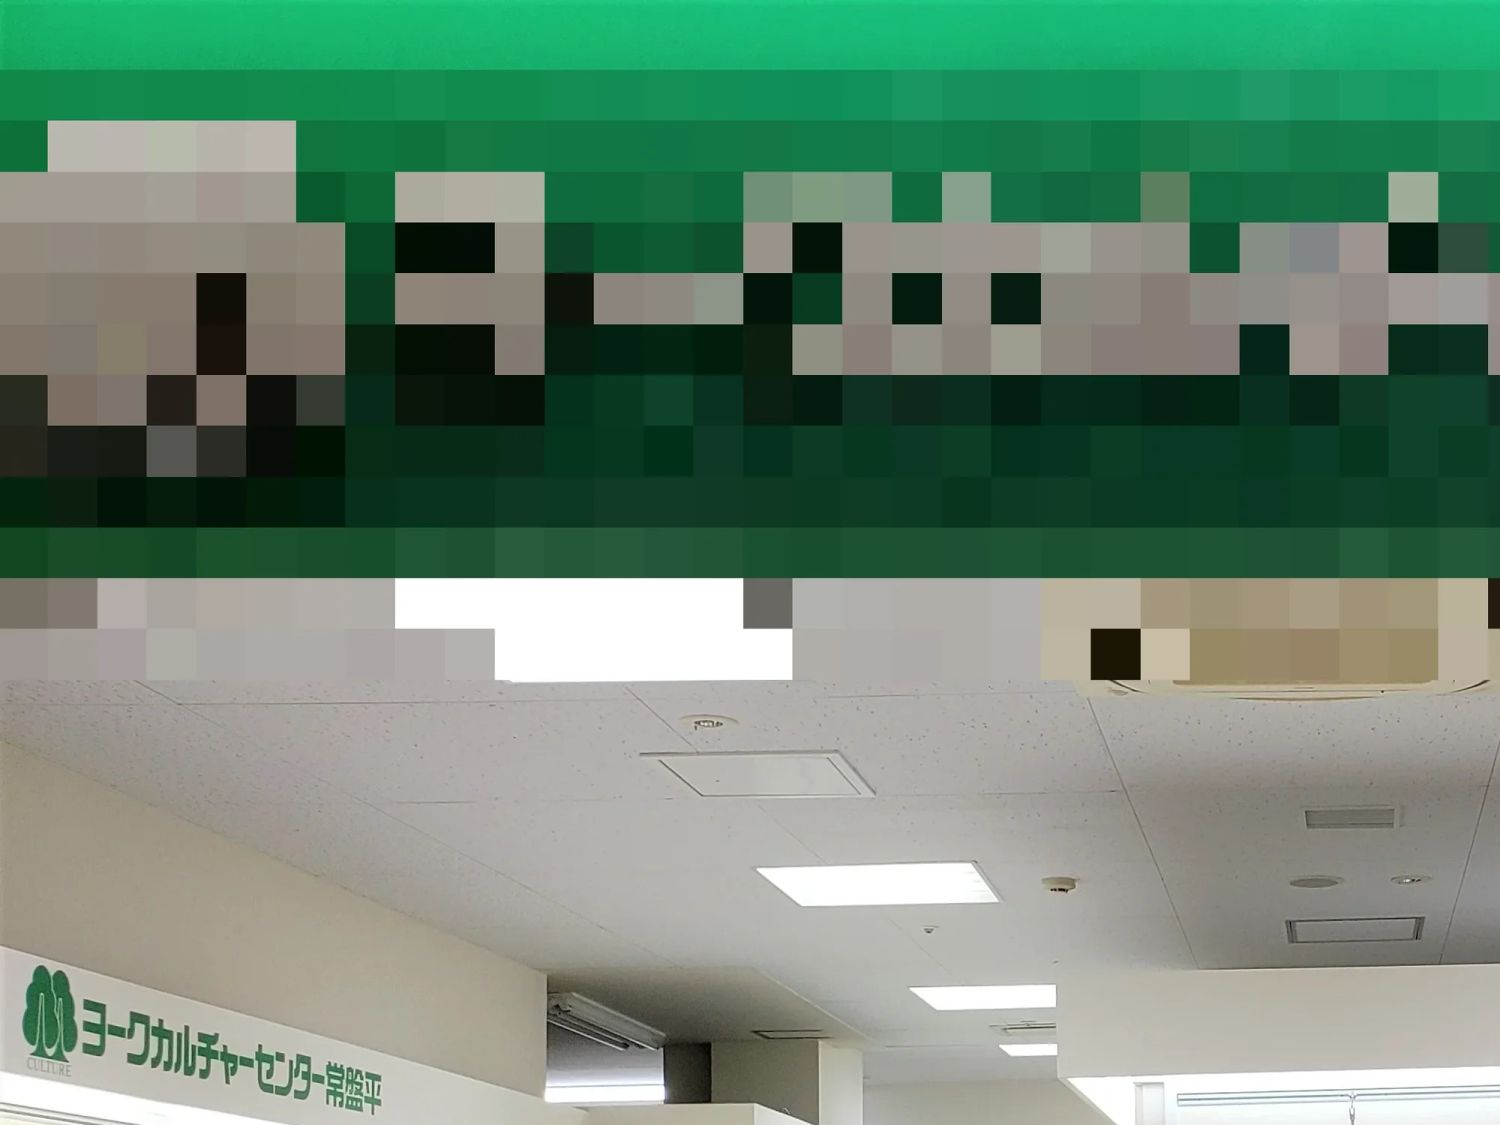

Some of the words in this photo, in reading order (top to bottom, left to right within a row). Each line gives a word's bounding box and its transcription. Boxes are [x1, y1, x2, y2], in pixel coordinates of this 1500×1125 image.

[26, 1057, 73, 1077] CULTURE
[82, 998, 383, 1116] ヨークカルチャーセンター常盤平
